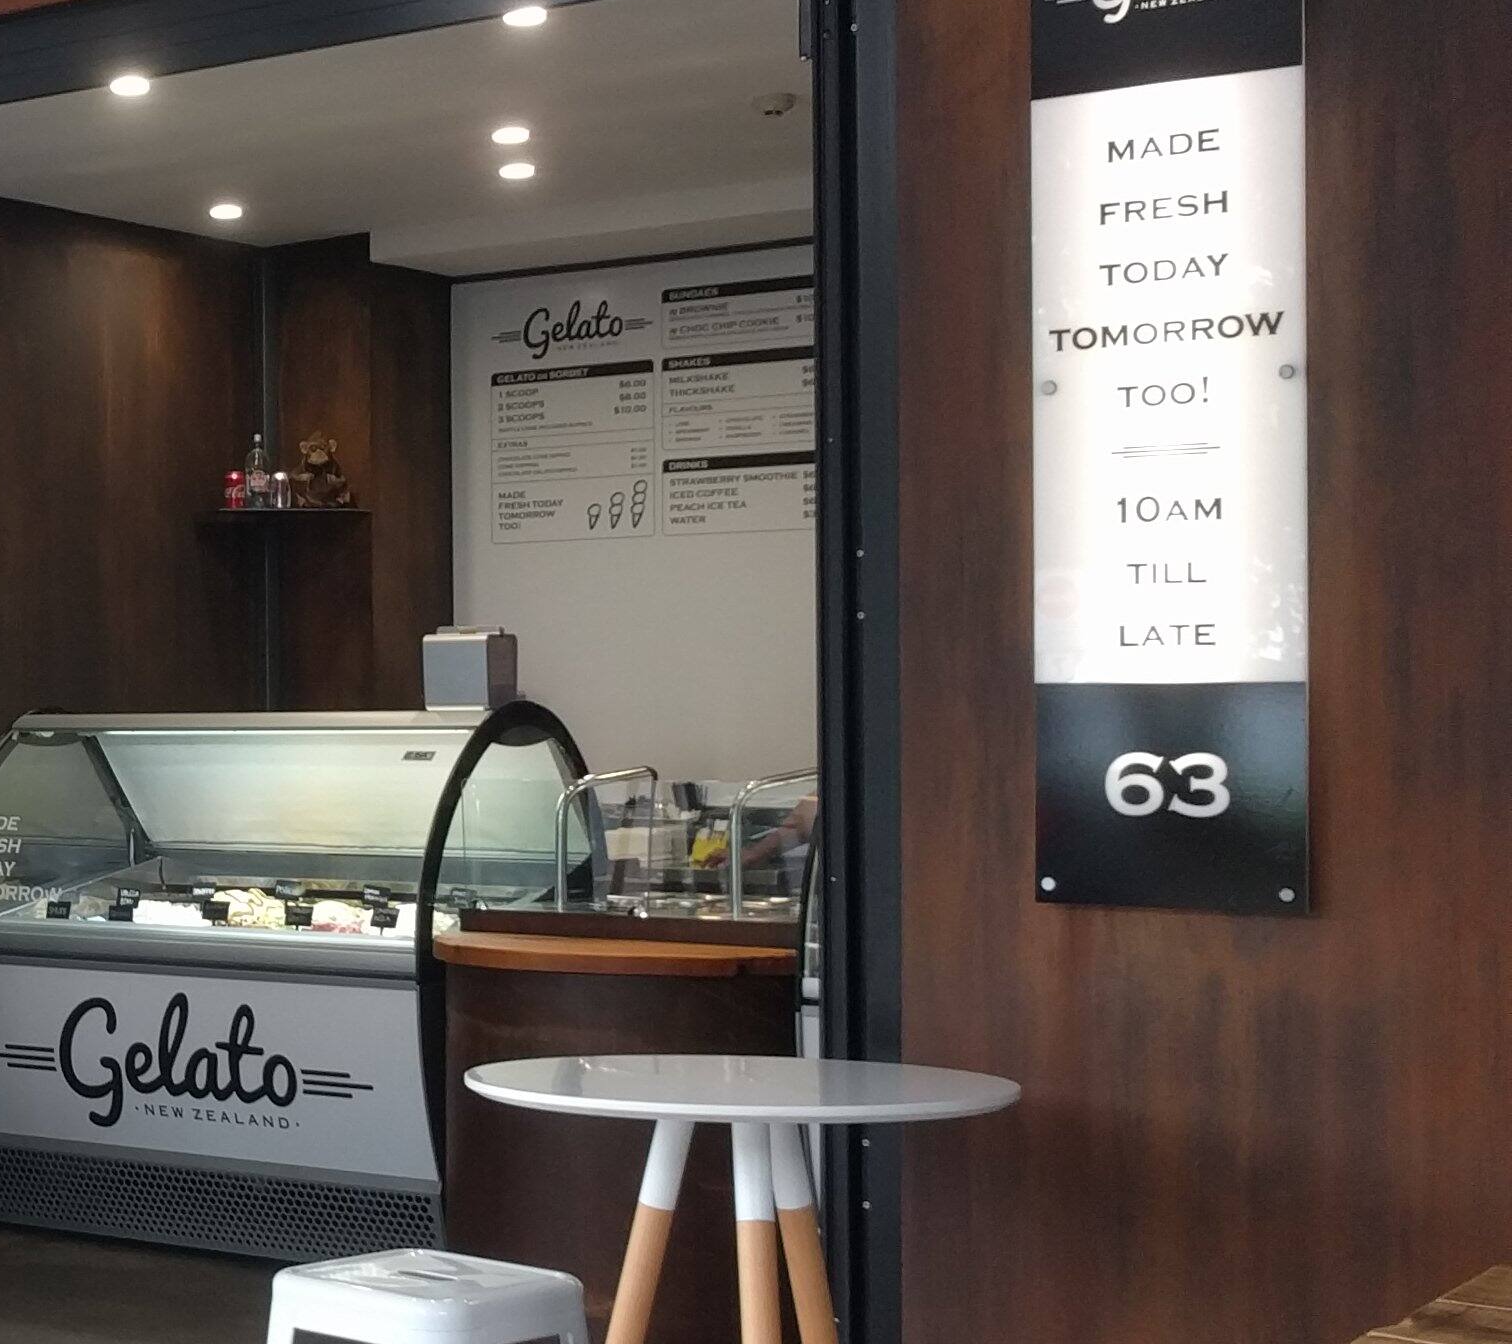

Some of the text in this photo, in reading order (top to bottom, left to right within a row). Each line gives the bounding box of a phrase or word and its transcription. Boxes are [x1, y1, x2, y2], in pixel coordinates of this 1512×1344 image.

[1107, 128, 1221, 163] MADE
[1099, 190, 1229, 225] FRESH
[1099, 253, 1229, 286] TODAY
[522, 299, 624, 360] Gelato
[1049, 311, 1284, 353] TOMORROW
[496, 371, 536, 385] GELATO
[1117, 376, 1209, 408] TOO!
[1116, 496, 1223, 523] 10AM
[1127, 563, 1207, 584] TILL
[1119, 624, 1216, 647] LATE
[1104, 751, 1231, 819] 63
[59, 992, 298, 1127] Gelato
[144, 1103, 289, 1130] NEW ZEALAND
